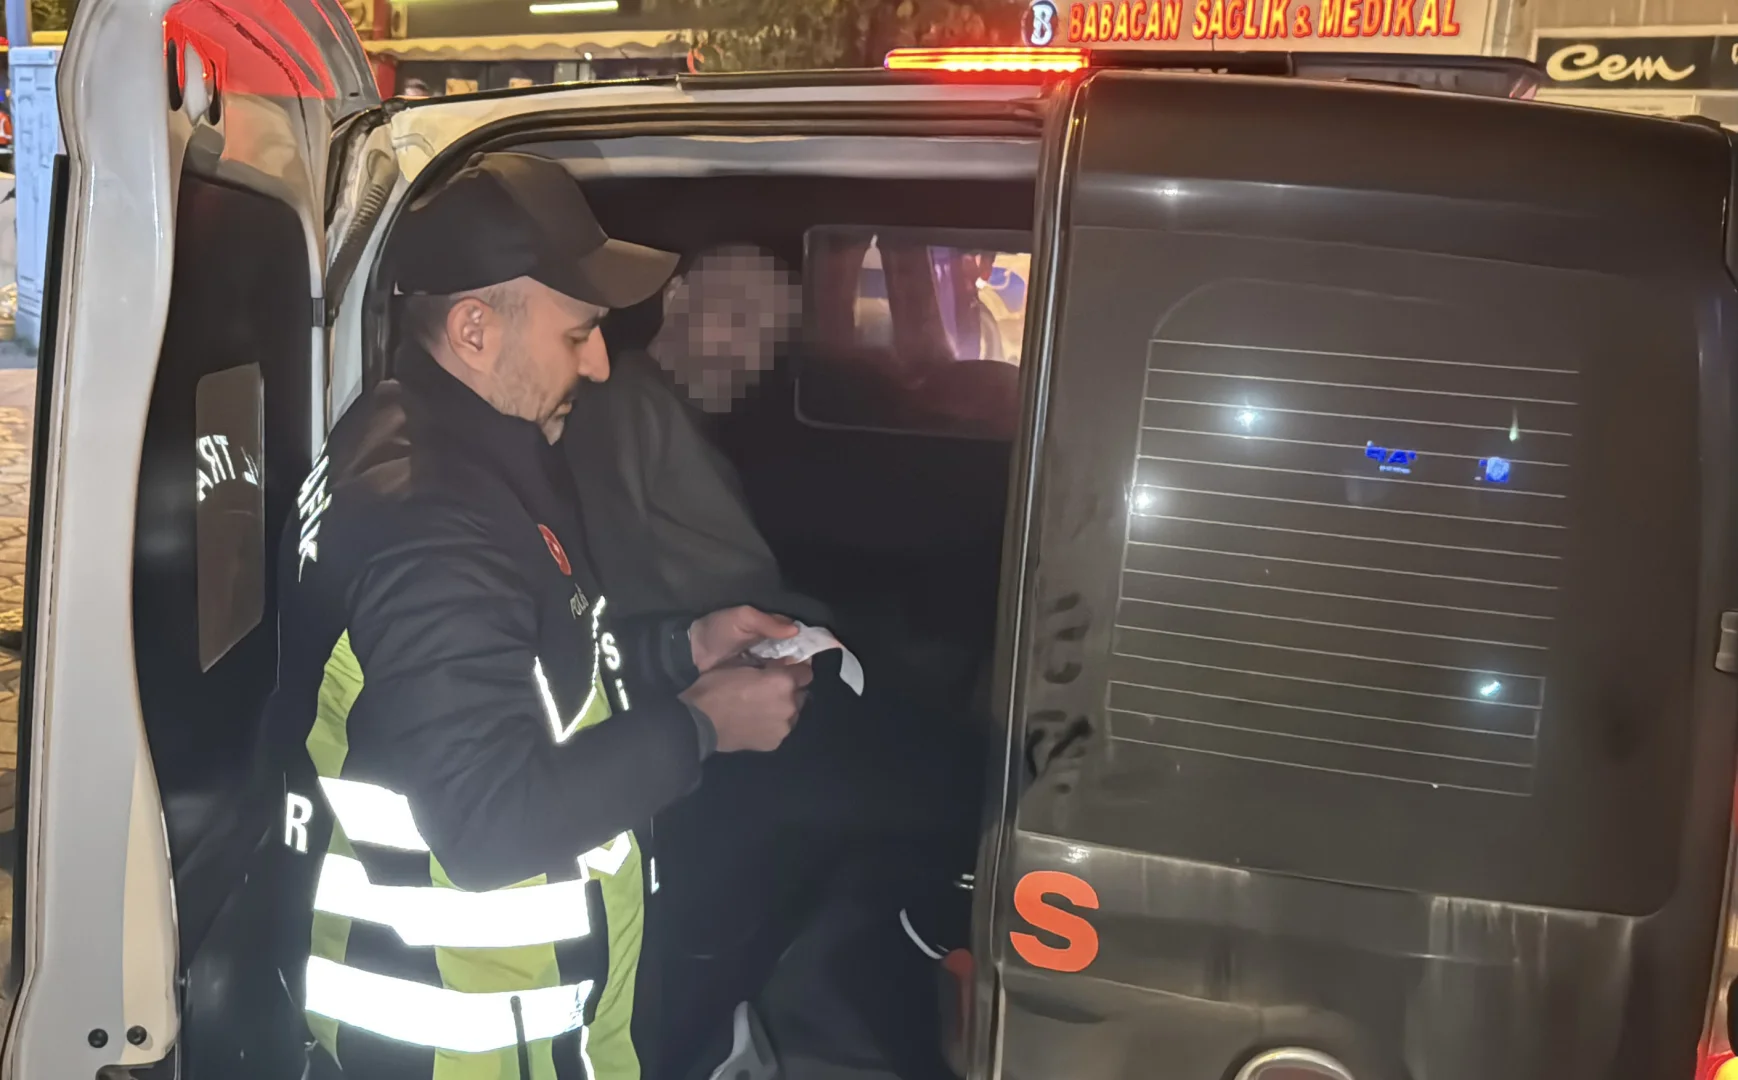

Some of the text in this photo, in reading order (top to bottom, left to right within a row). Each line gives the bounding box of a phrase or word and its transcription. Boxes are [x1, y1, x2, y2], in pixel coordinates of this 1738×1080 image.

[1068, 0, 1183, 42] BABACAN
[1292, 6, 1312, 38] &
[1546, 44, 1696, 81] Cem
[1010, 870, 1099, 972] S
